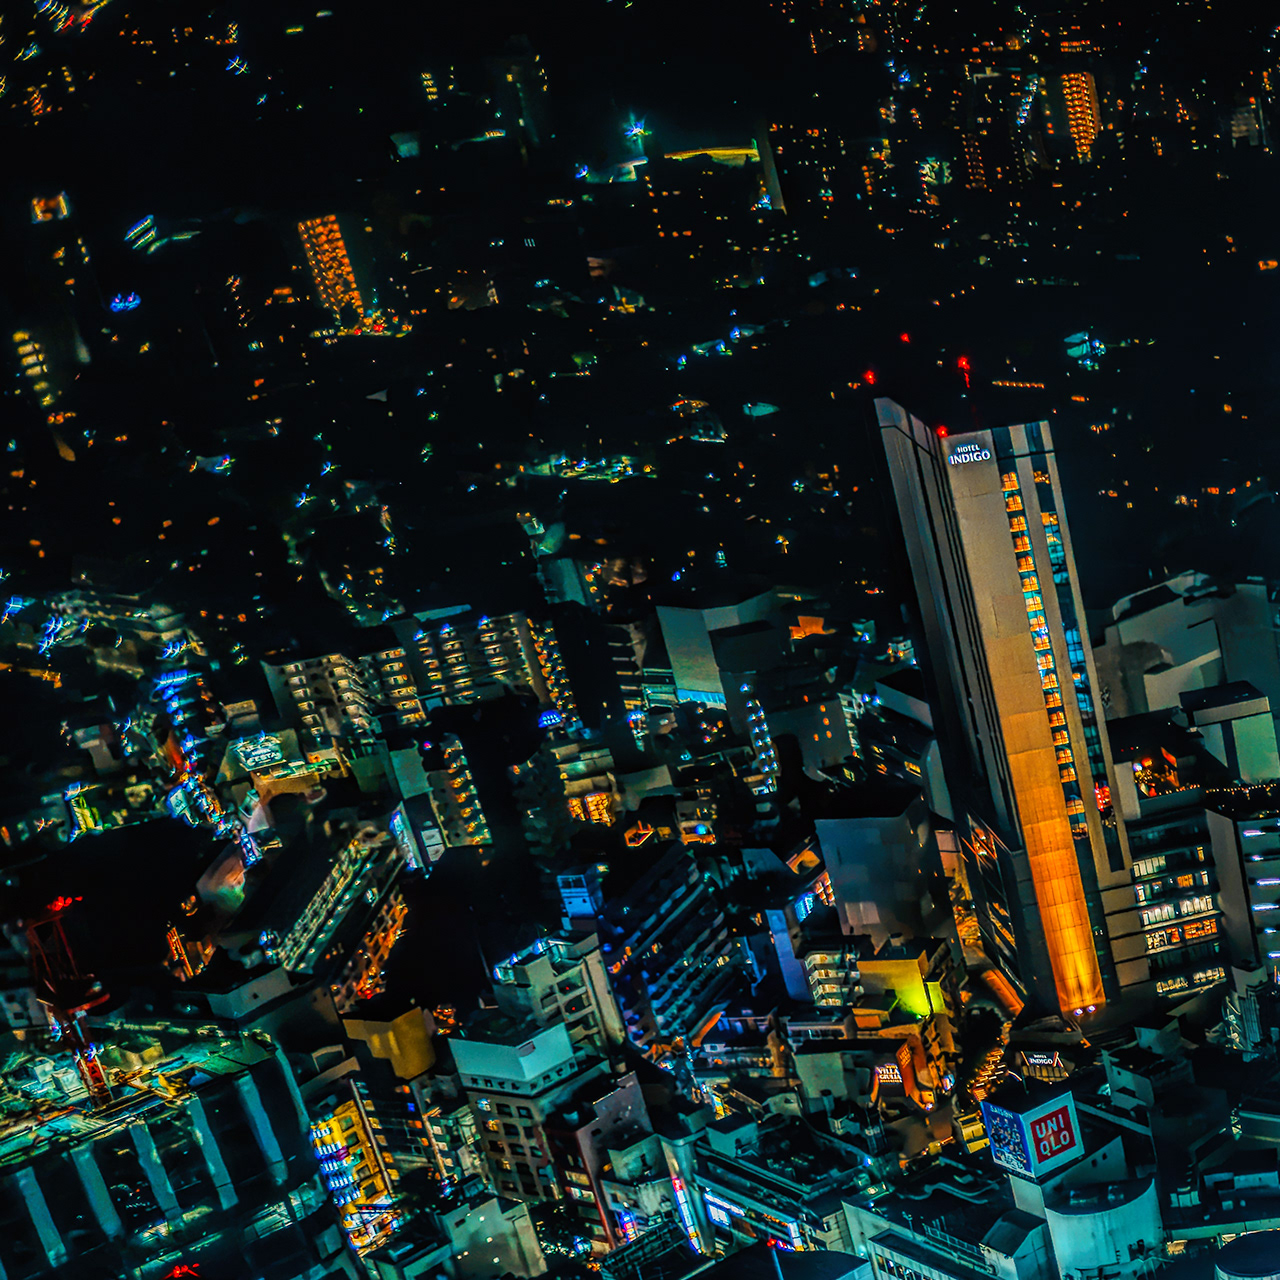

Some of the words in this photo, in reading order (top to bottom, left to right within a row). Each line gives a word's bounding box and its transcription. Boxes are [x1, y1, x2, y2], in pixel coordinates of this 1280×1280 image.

[956, 444, 980, 452] HOTEL
[949, 450, 991, 465] INDIGO
[1029, 1057, 1055, 1067] INDIGO
[1035, 1117, 1067, 1138] UNI
[1039, 1130, 1071, 1158] QLO
